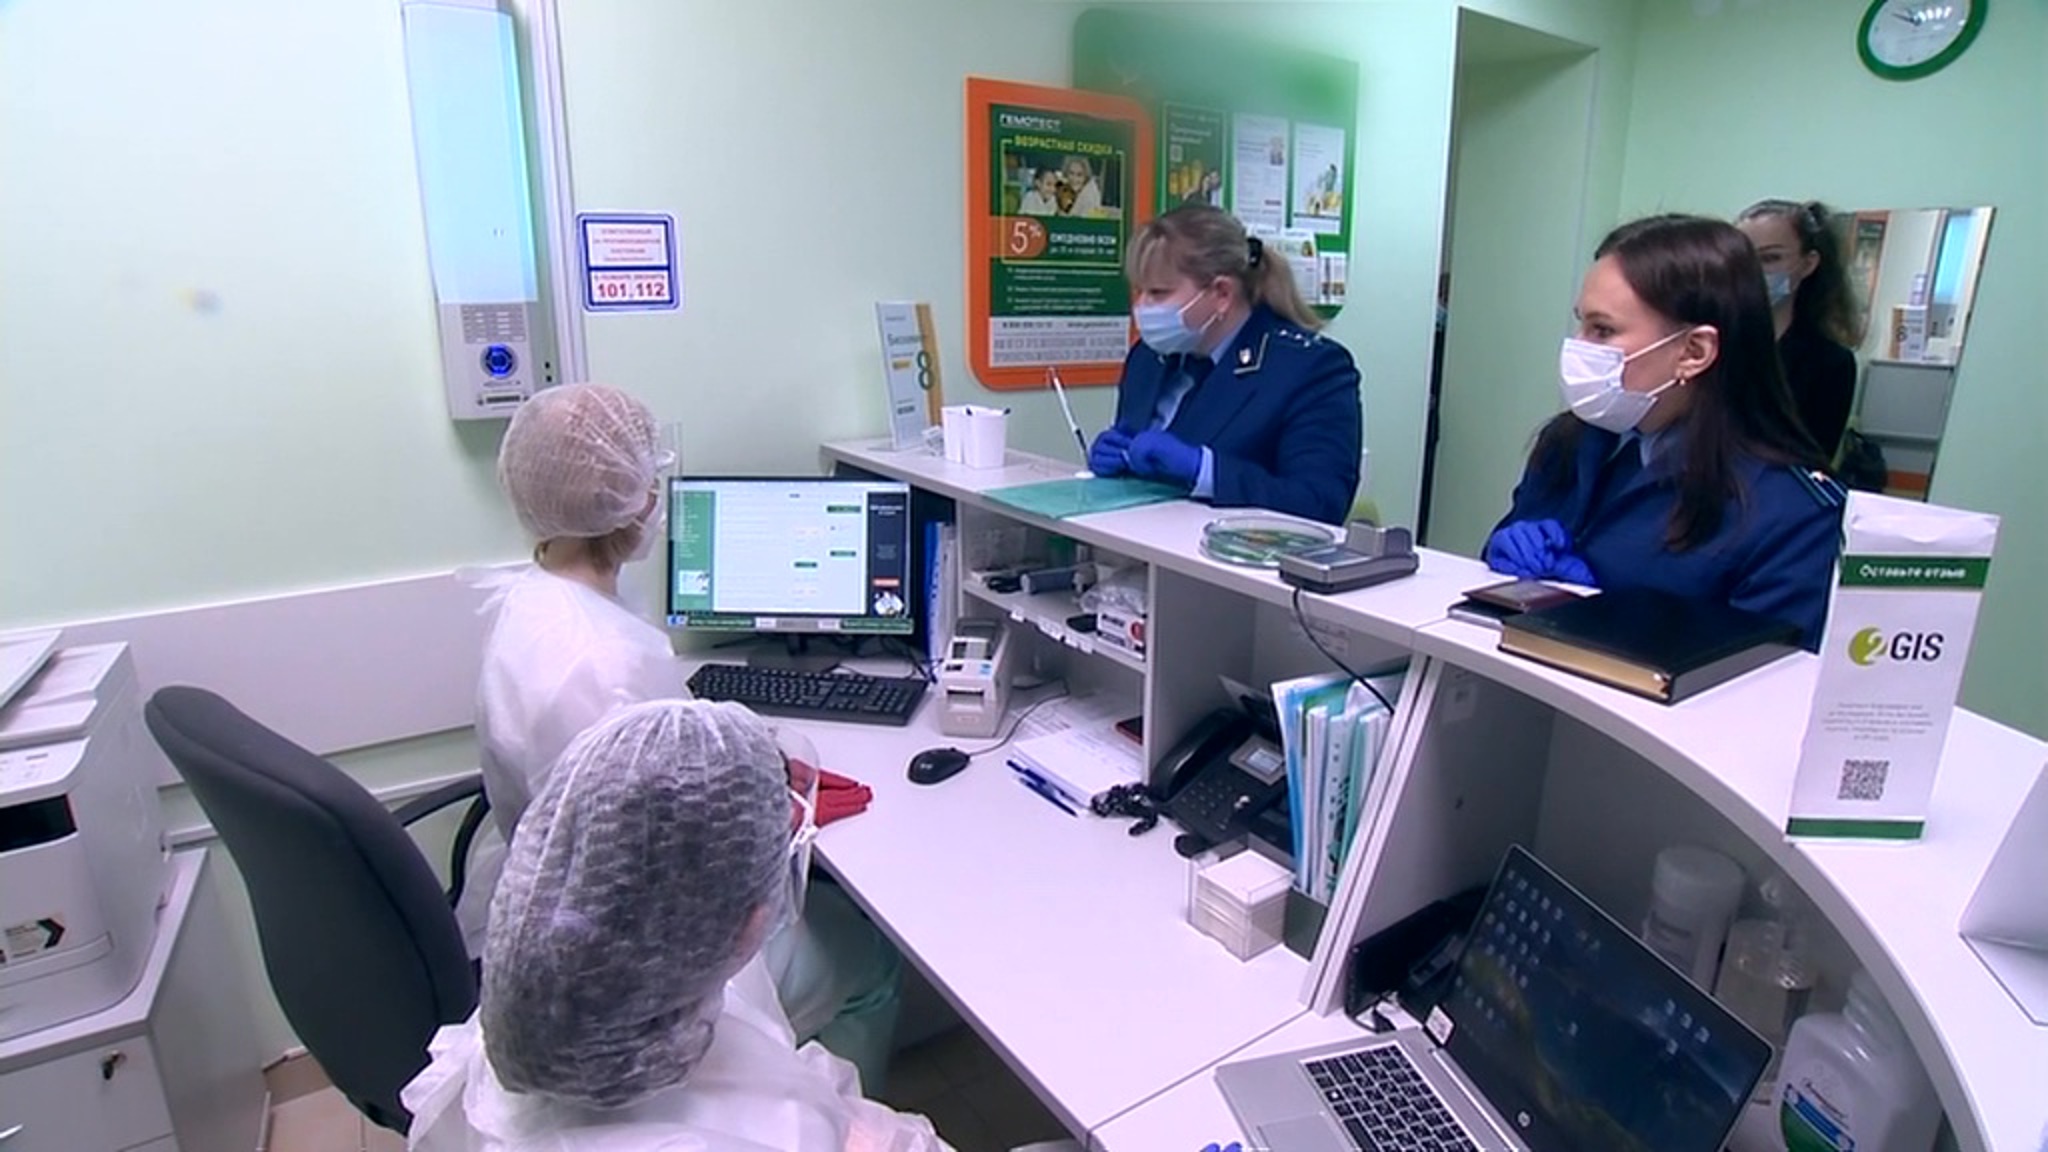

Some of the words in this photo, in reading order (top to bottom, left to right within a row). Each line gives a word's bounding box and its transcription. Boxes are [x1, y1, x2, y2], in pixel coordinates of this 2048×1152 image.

[1000, 113, 1061, 129] ГЕМОТЕСТ
[1015, 135, 1075, 151] ВОЗРАСТНАЯ
[1077, 142, 1113, 156] СКИДКА
[917, 350, 935, 390] 8
[1859, 563, 1922, 579] Оставьте
[1924, 566, 1967, 579] отзыв
[1862, 630, 1945, 662] 2GIS
